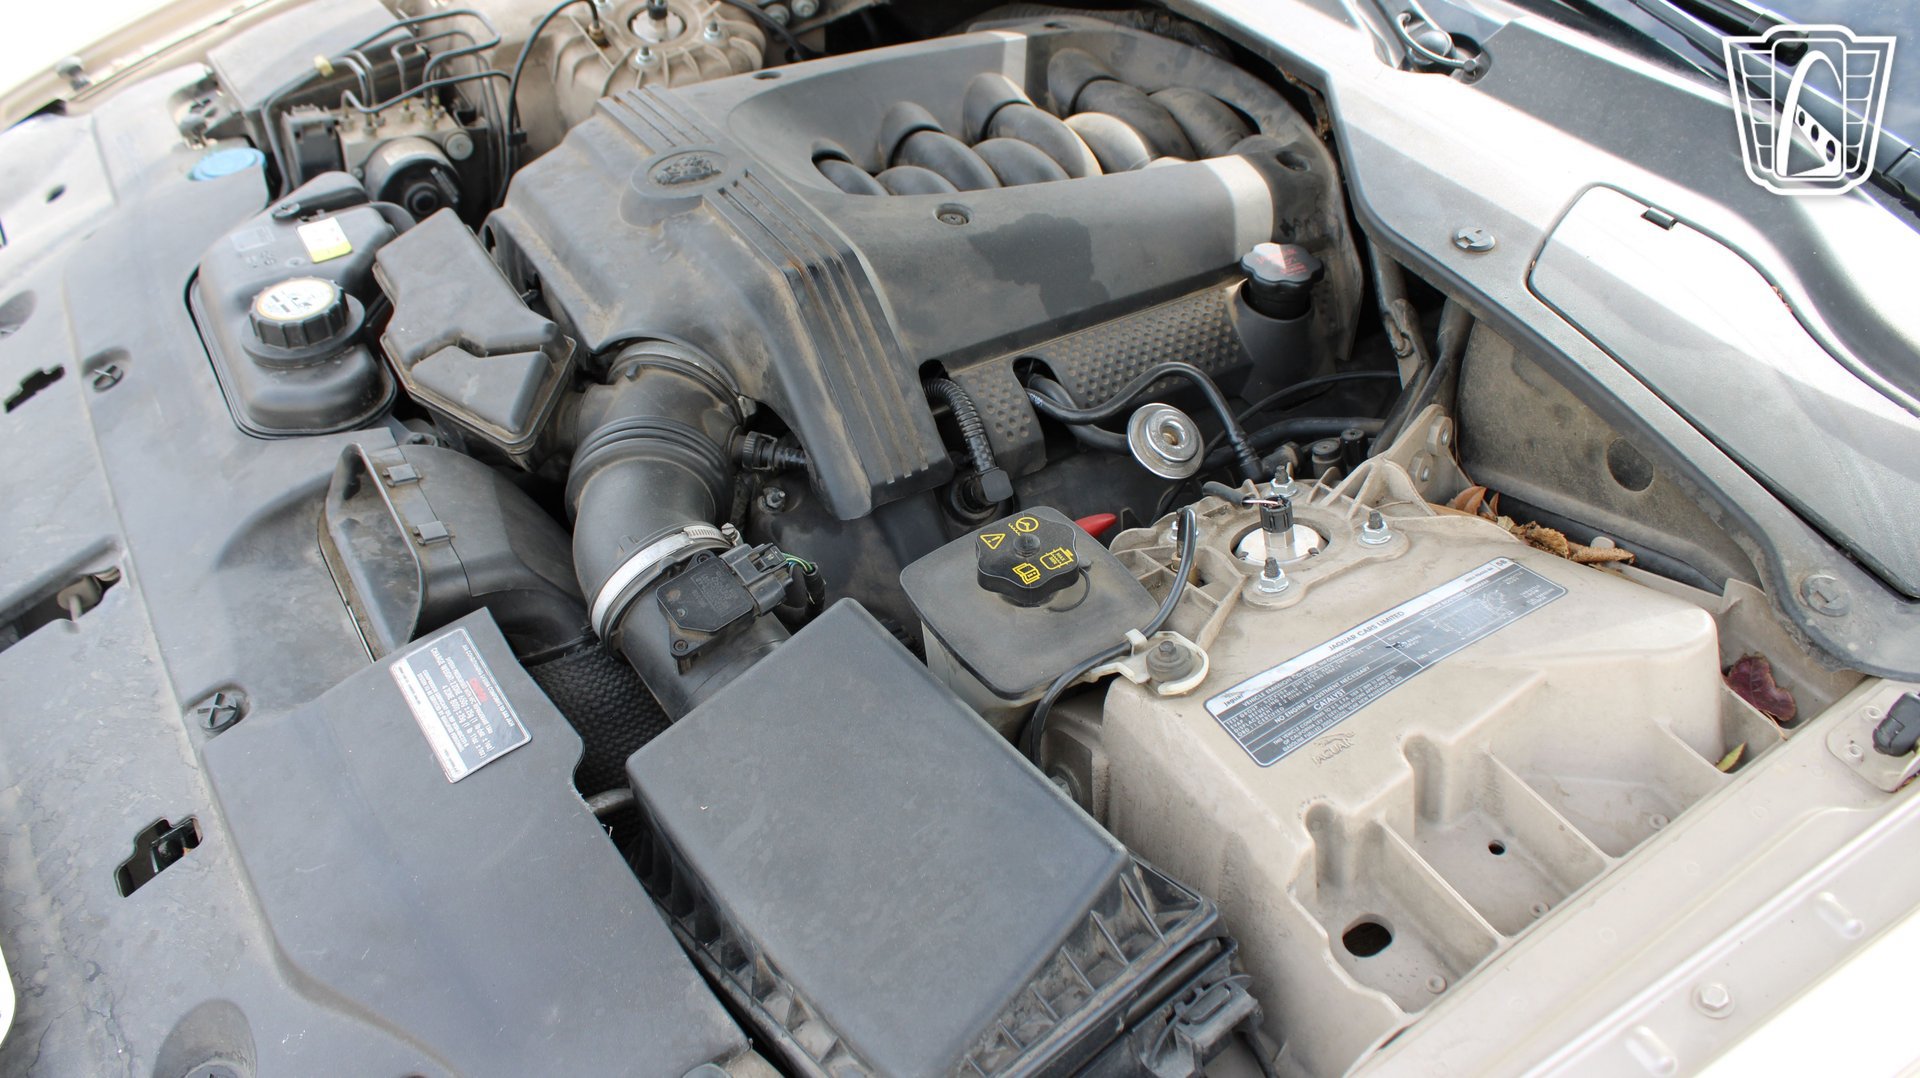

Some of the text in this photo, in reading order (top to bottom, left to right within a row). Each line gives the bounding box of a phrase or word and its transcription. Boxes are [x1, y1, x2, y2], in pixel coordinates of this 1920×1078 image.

[1327, 610, 1405, 650] JAGUAR CARS LIMITED
[1241, 692, 1265, 707] VEHICLE
[1264, 677, 1292, 694] EMISSION
[1291, 664, 1318, 679] CONTROL
[1273, 714, 1285, 723] NO
[1283, 701, 1306, 717] ENGINE
[1305, 682, 1341, 704] ADJUSTMENT
[1339, 665, 1370, 684] NECESSARY
[1223, 693, 1244, 706] jaguar
[1312, 688, 1347, 711] CATALYST
[1226, 716, 1239, 725] TEST
[1238, 705, 1258, 718] GROUP
[1233, 707, 1273, 732] DISPLACEMENT
[1256, 706, 1285, 724] CERTIFIED
[1281, 726, 1300, 739] VEHICLE
[1298, 711, 1325, 728] CONFORMS
[1289, 722, 1316, 740] CALIFORNIA
[1311, 738, 1355, 767] JAGUAR
